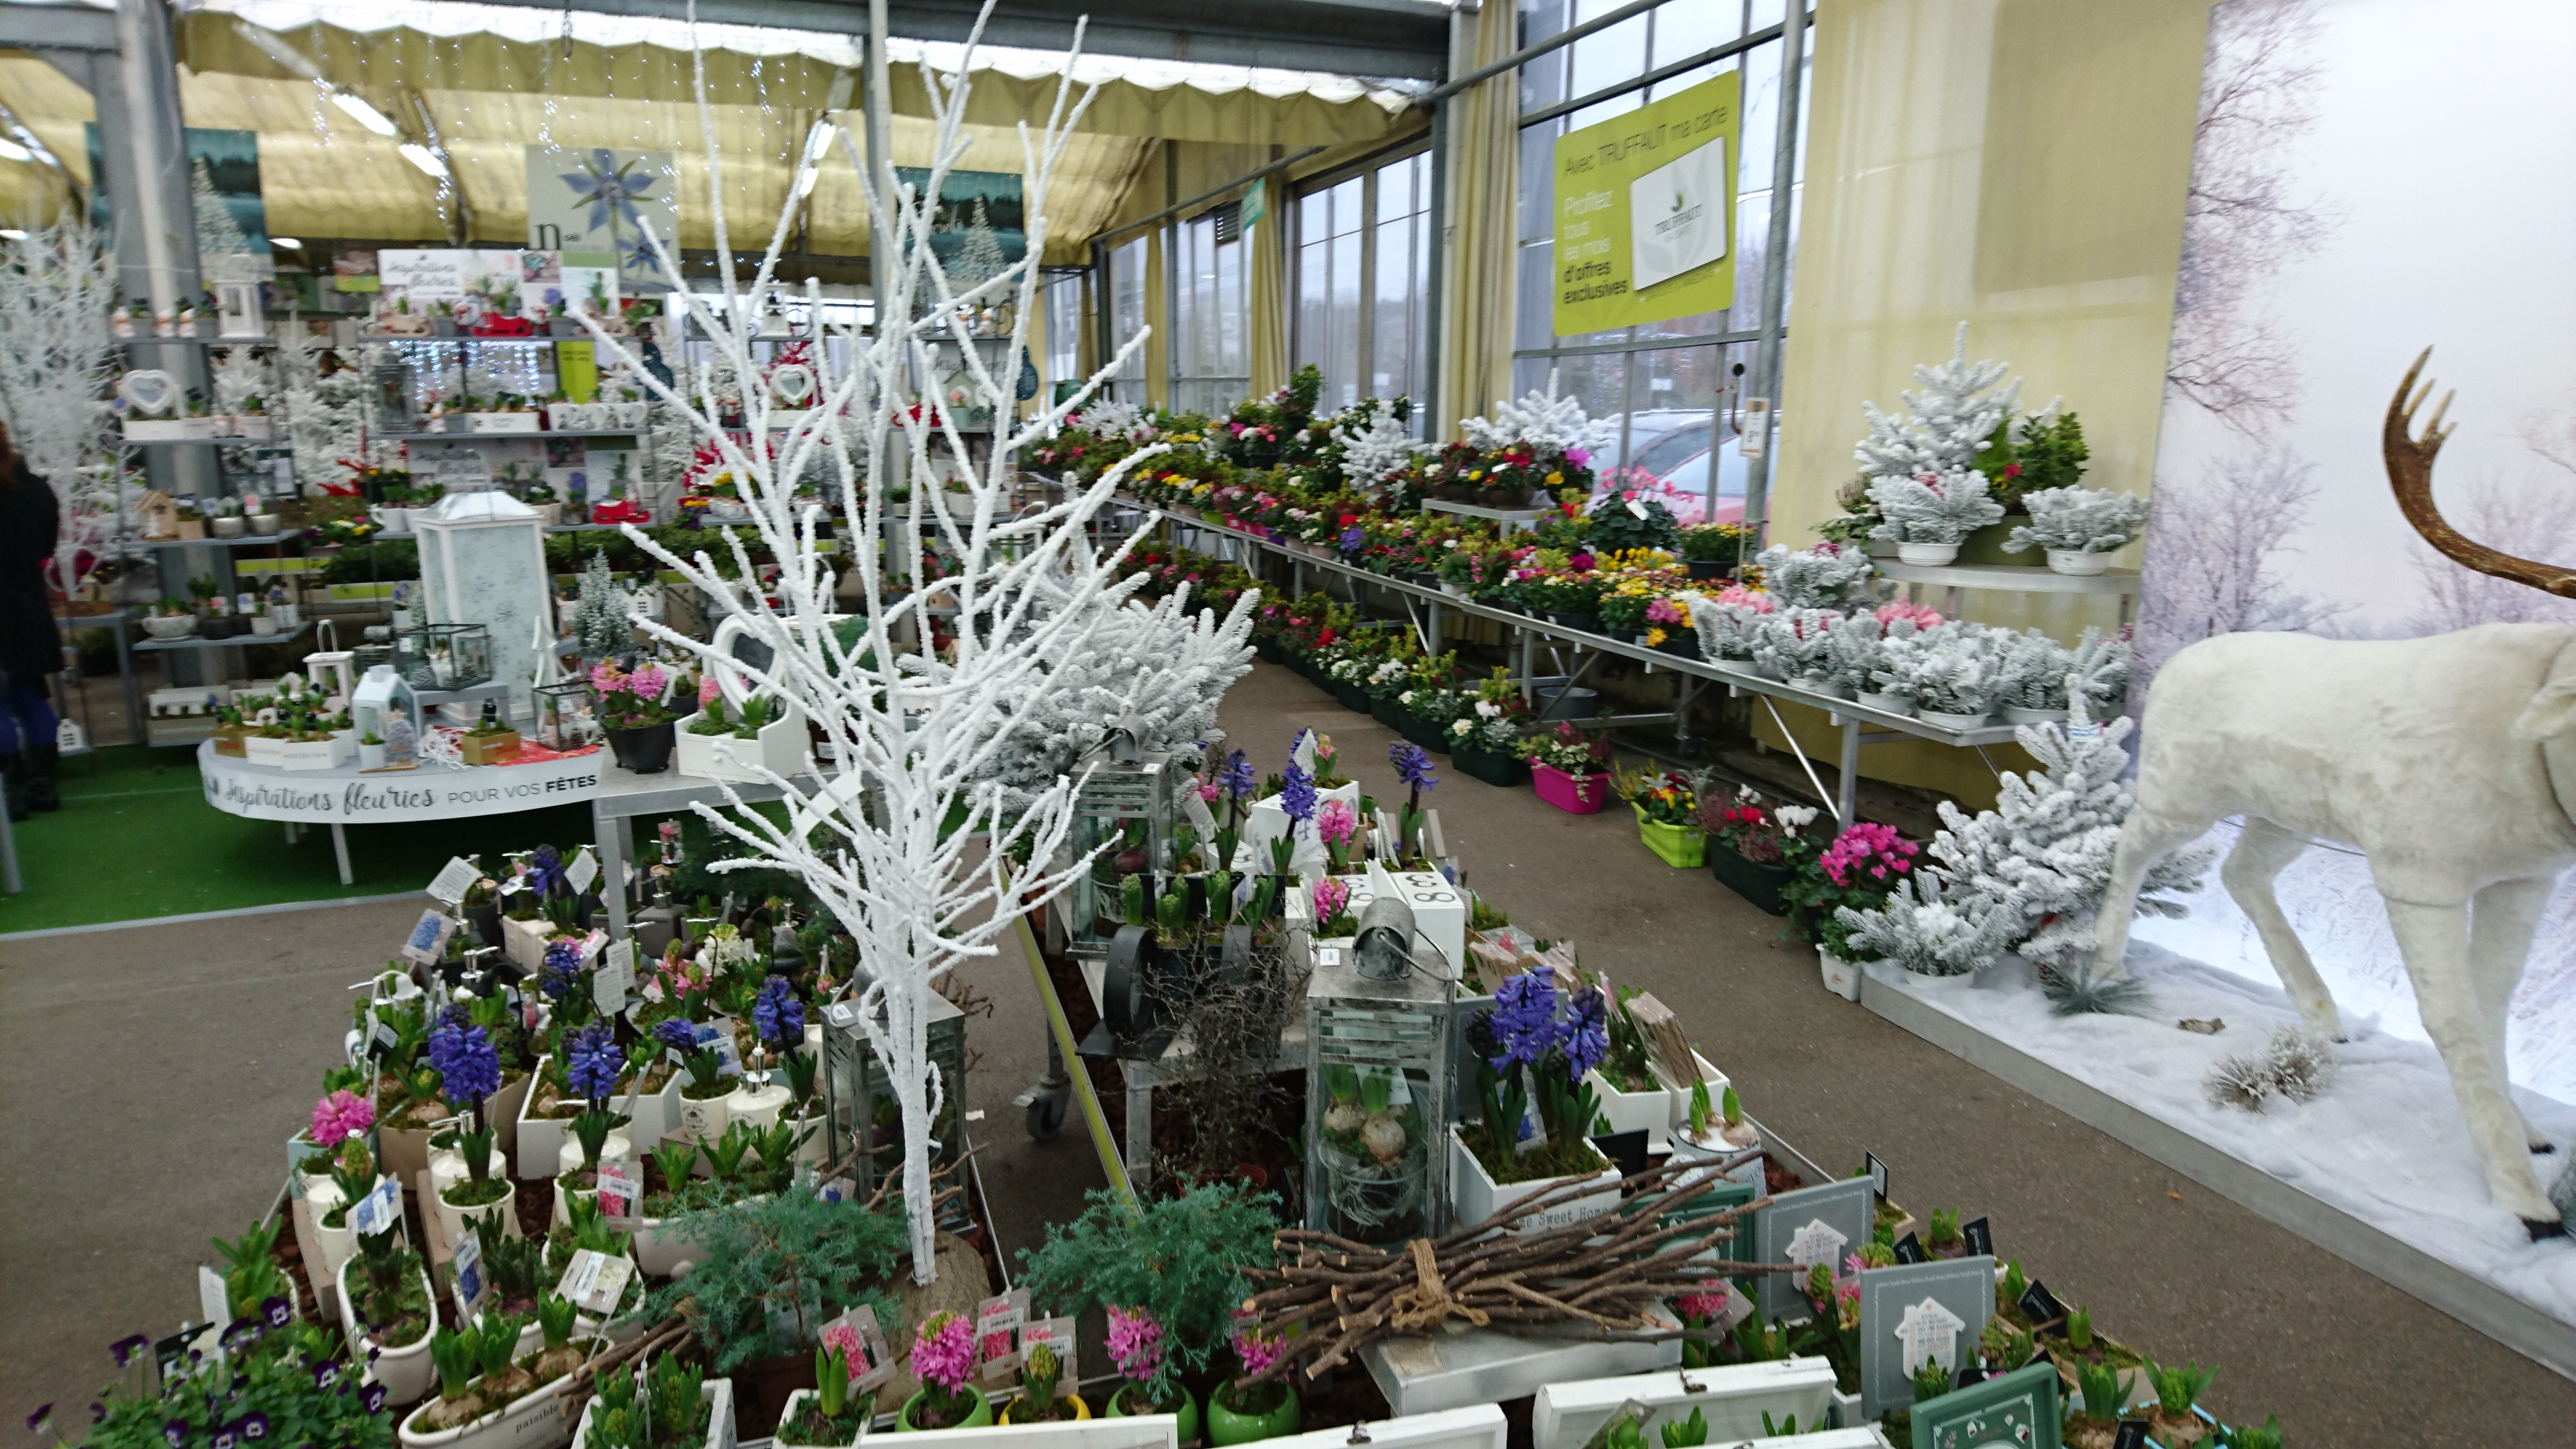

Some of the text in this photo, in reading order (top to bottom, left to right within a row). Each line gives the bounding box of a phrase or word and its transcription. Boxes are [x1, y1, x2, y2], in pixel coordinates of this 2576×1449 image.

[1597, 123, 1668, 166] TRUFFAUT
[1564, 191, 1613, 219] Profitez
[1564, 220, 1591, 240] tous
[1581, 234, 1612, 258] mois
[1563, 261, 1612, 284] d'offres
[1563, 279, 1629, 305] exclusives
[343, 782, 435, 816] fleuries
[447, 788, 499, 804] POUR
[504, 783, 541, 798] VOS
[545, 774, 597, 793] FÊTES
[1538, 1211, 1573, 1226] Sweet
[1579, 1206, 1609, 1220] Home
[516, 1404, 559, 1434] paisible
